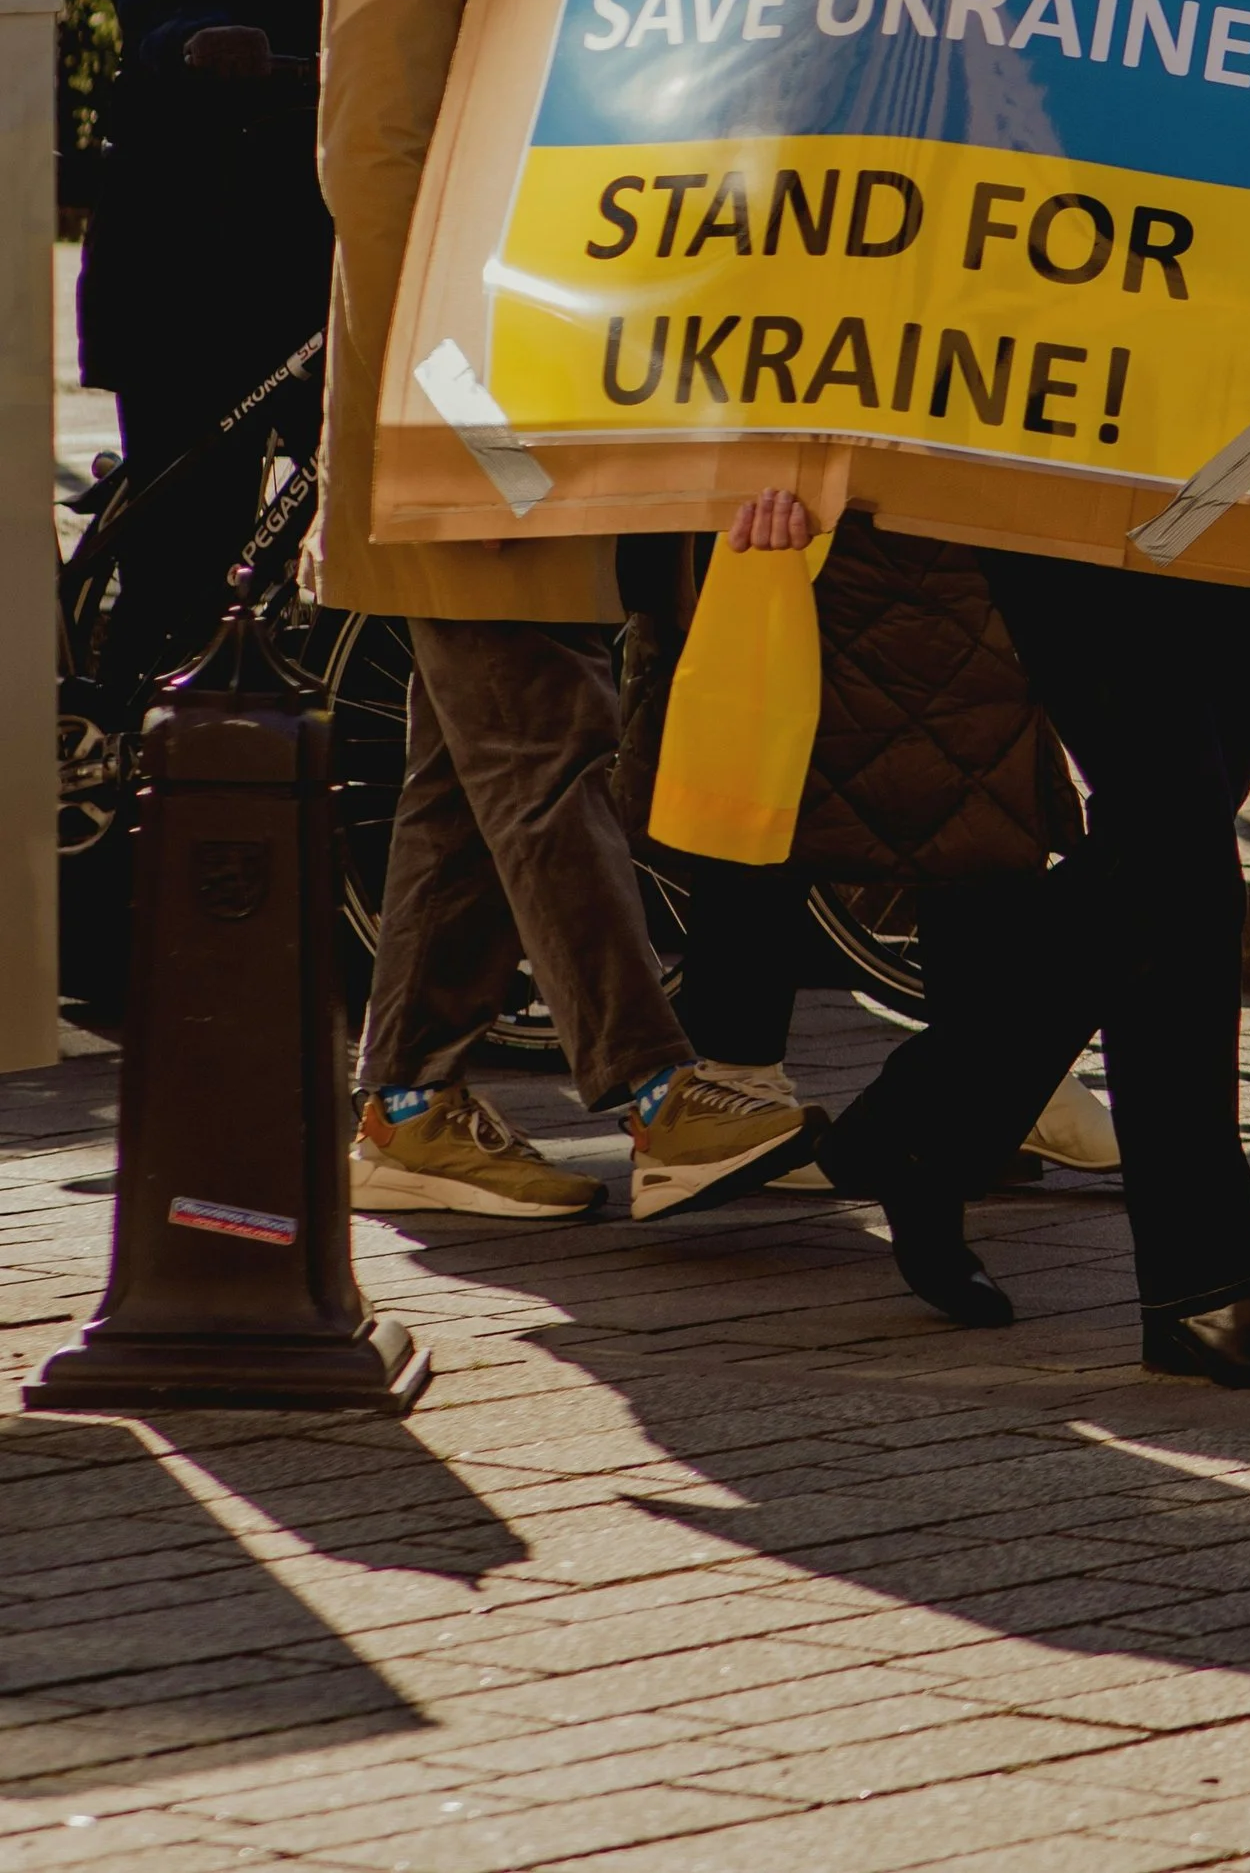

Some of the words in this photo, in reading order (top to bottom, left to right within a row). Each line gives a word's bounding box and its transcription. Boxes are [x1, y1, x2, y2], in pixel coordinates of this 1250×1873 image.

[585, 169, 925, 259] STAND
[962, 181, 1195, 300] FOR
[220, 365, 289, 432] STRONG
[602, 315, 1132, 444] UKRAINE!
[241, 446, 320, 567] PEGASU
